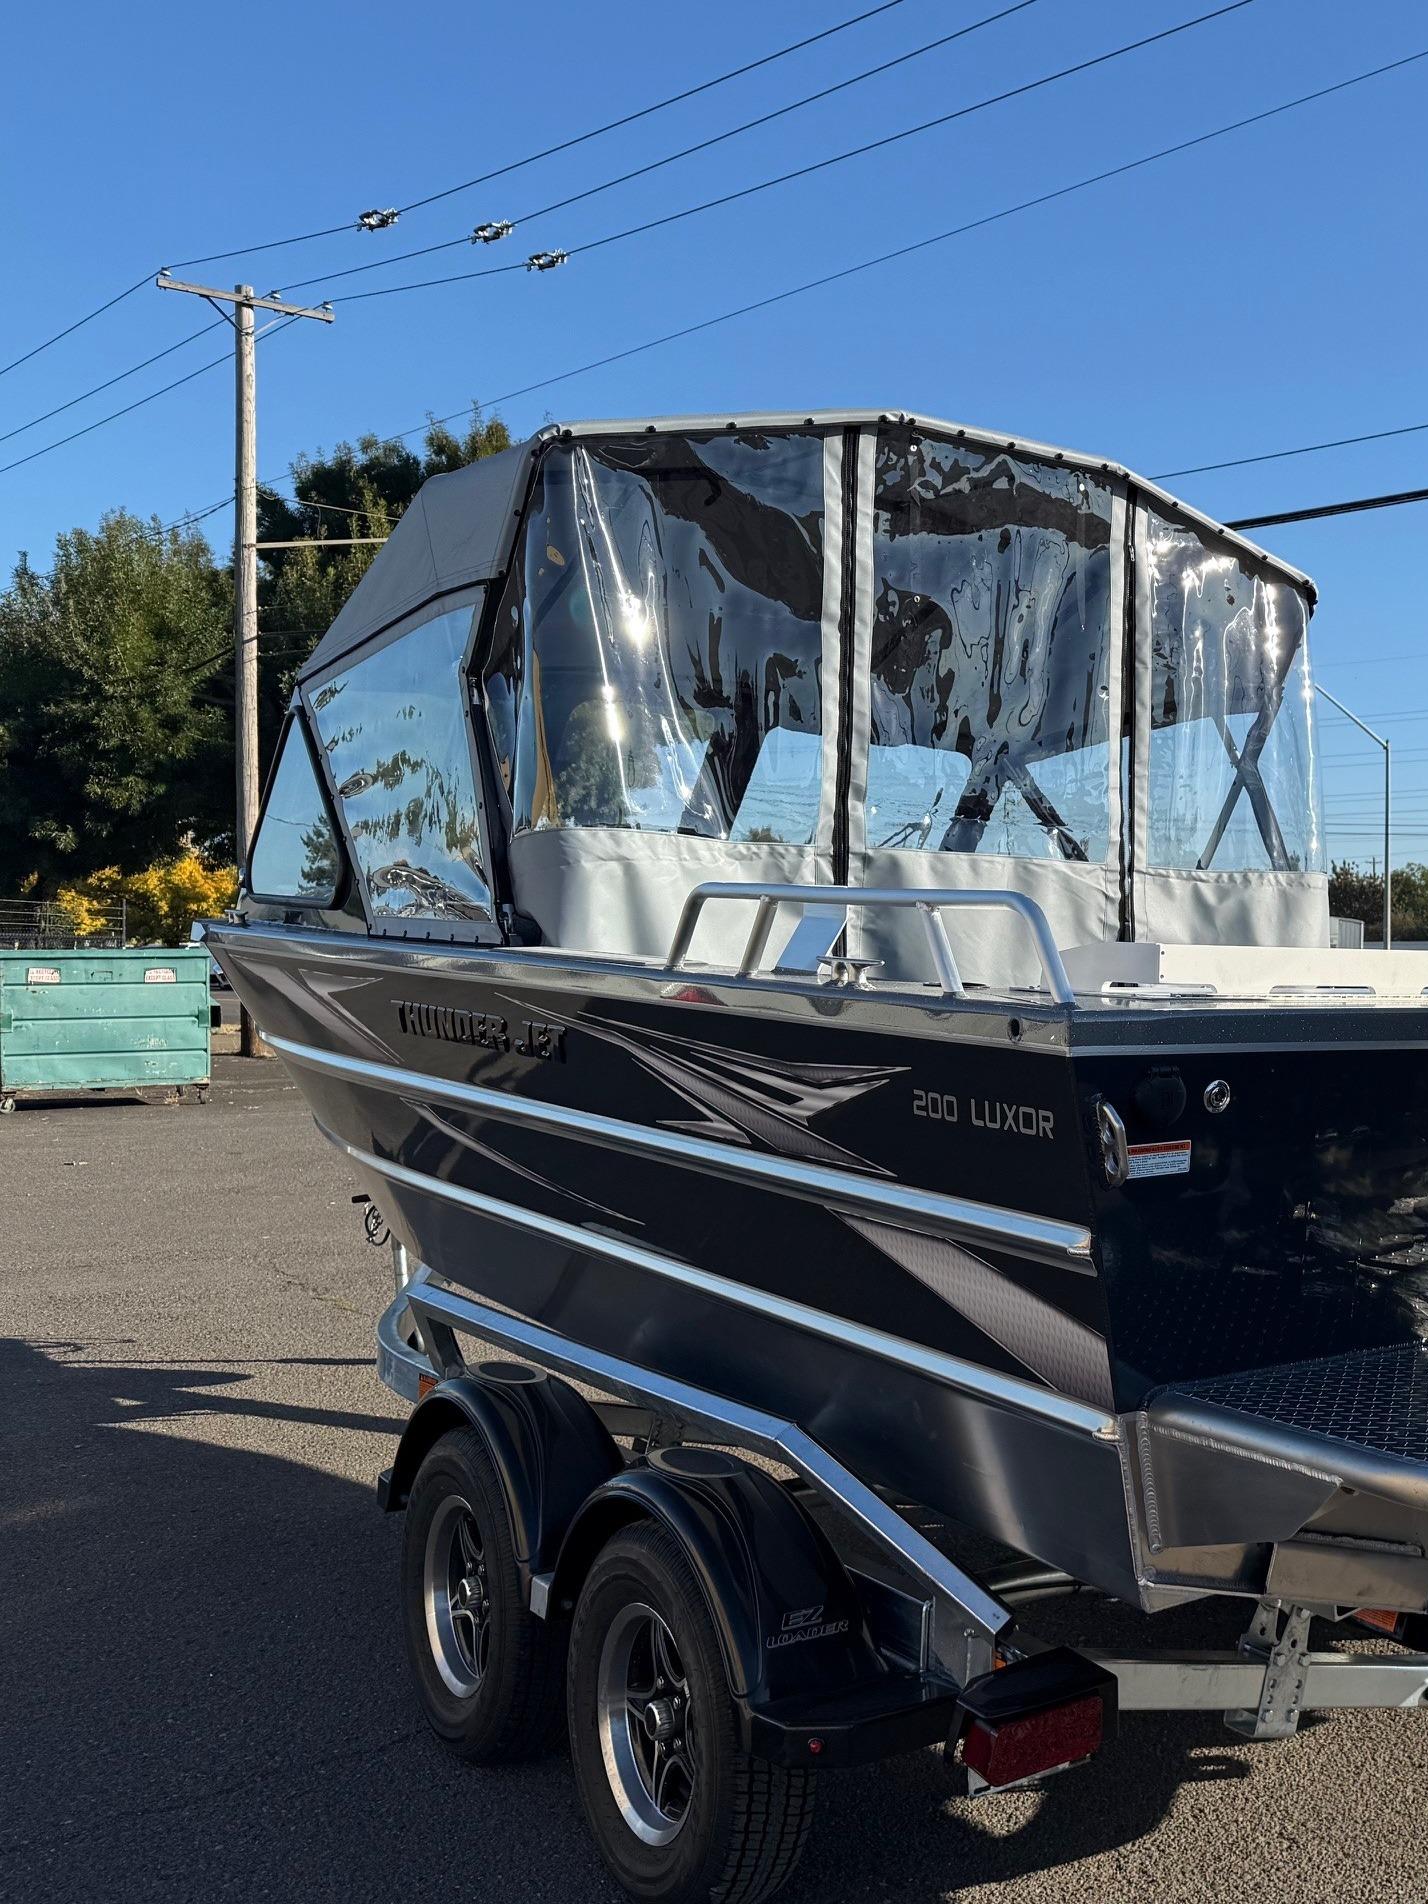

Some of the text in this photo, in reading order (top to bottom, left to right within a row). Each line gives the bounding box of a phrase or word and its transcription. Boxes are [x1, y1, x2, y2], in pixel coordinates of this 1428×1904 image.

[390, 1000, 568, 1064] THUNDER JET
[913, 1089, 1054, 1140] 200 LUXOR
[766, 1619, 849, 1649] LOADER
[781, 1604, 825, 1631] EZ
